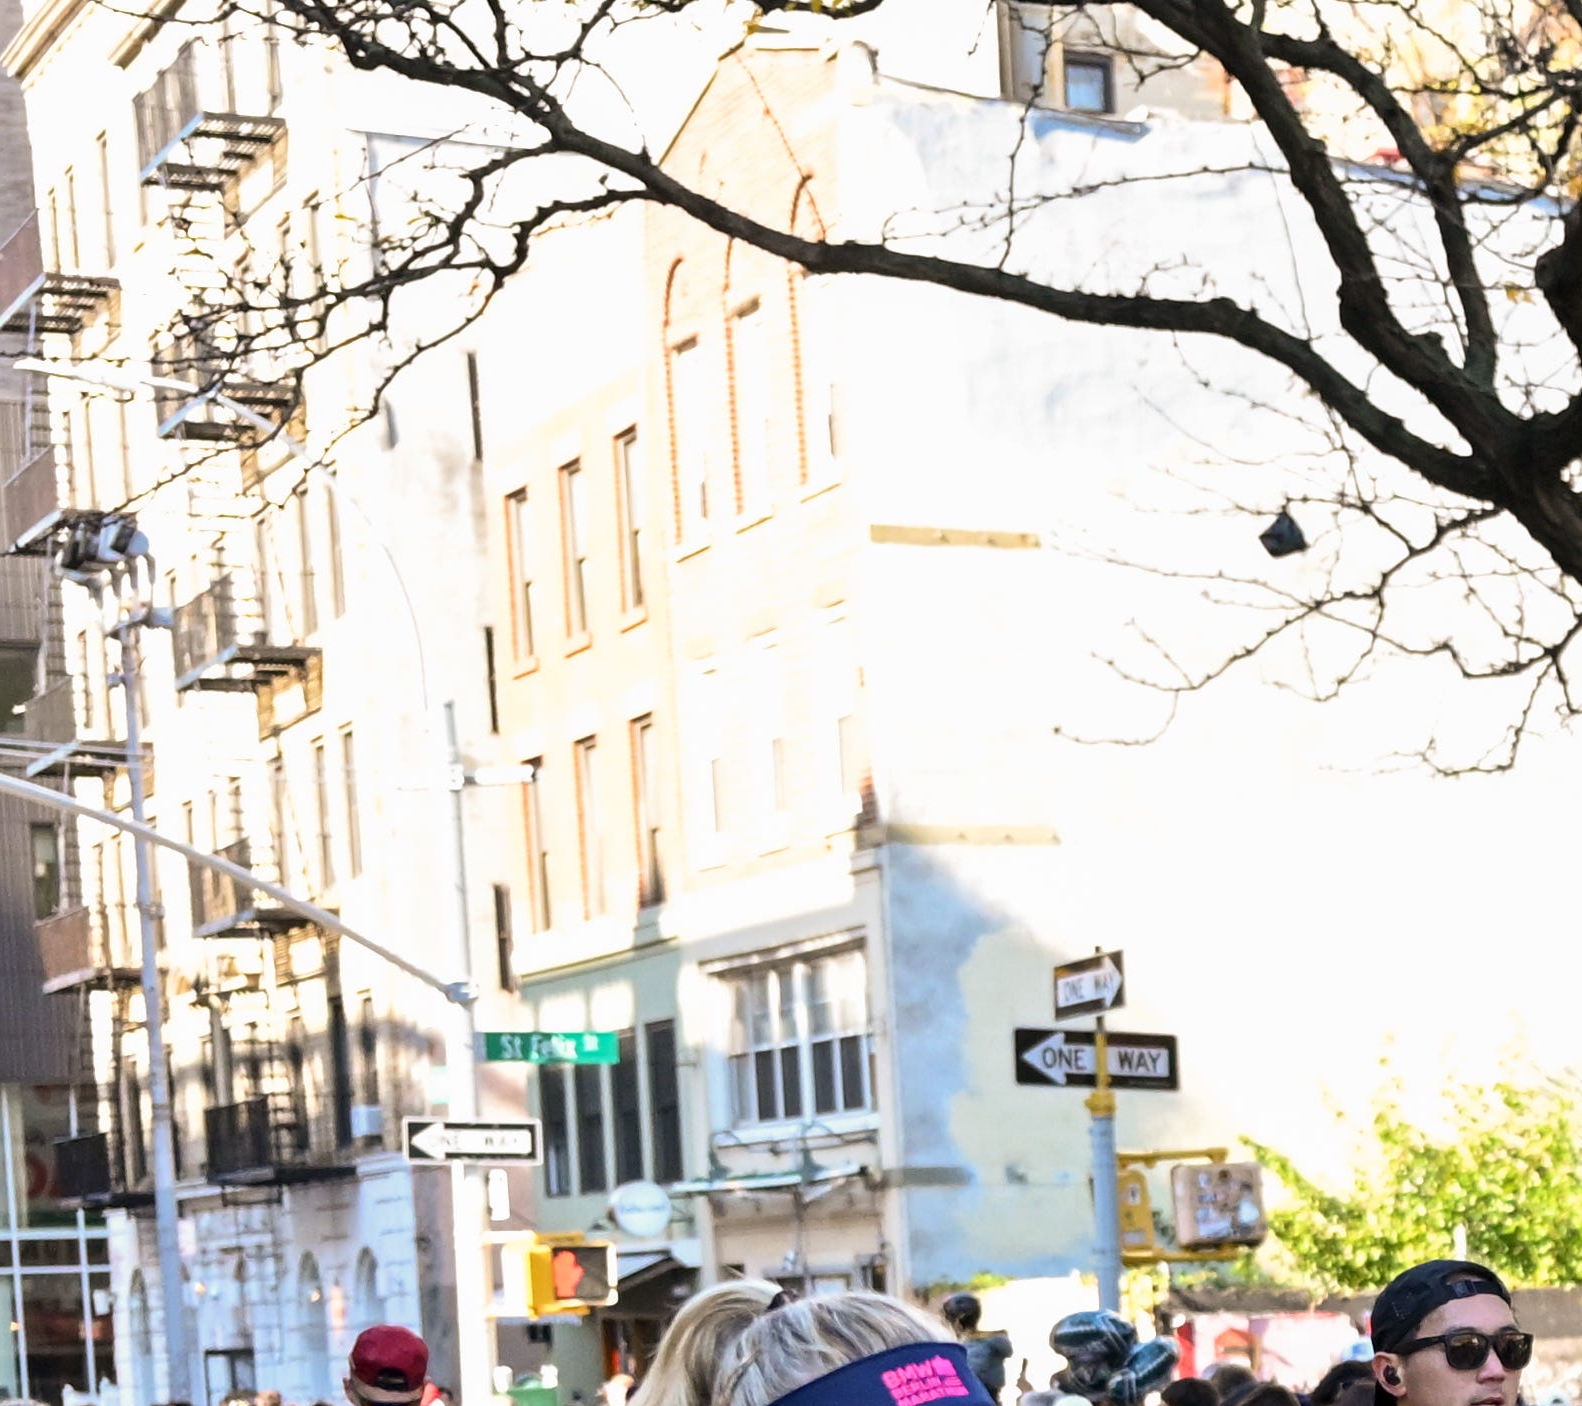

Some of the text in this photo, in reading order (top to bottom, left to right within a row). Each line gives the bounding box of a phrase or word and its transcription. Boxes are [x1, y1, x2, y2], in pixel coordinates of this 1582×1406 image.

[500, 1033, 523, 1060] St
[1042, 1046, 1162, 1073] ONE WAY
